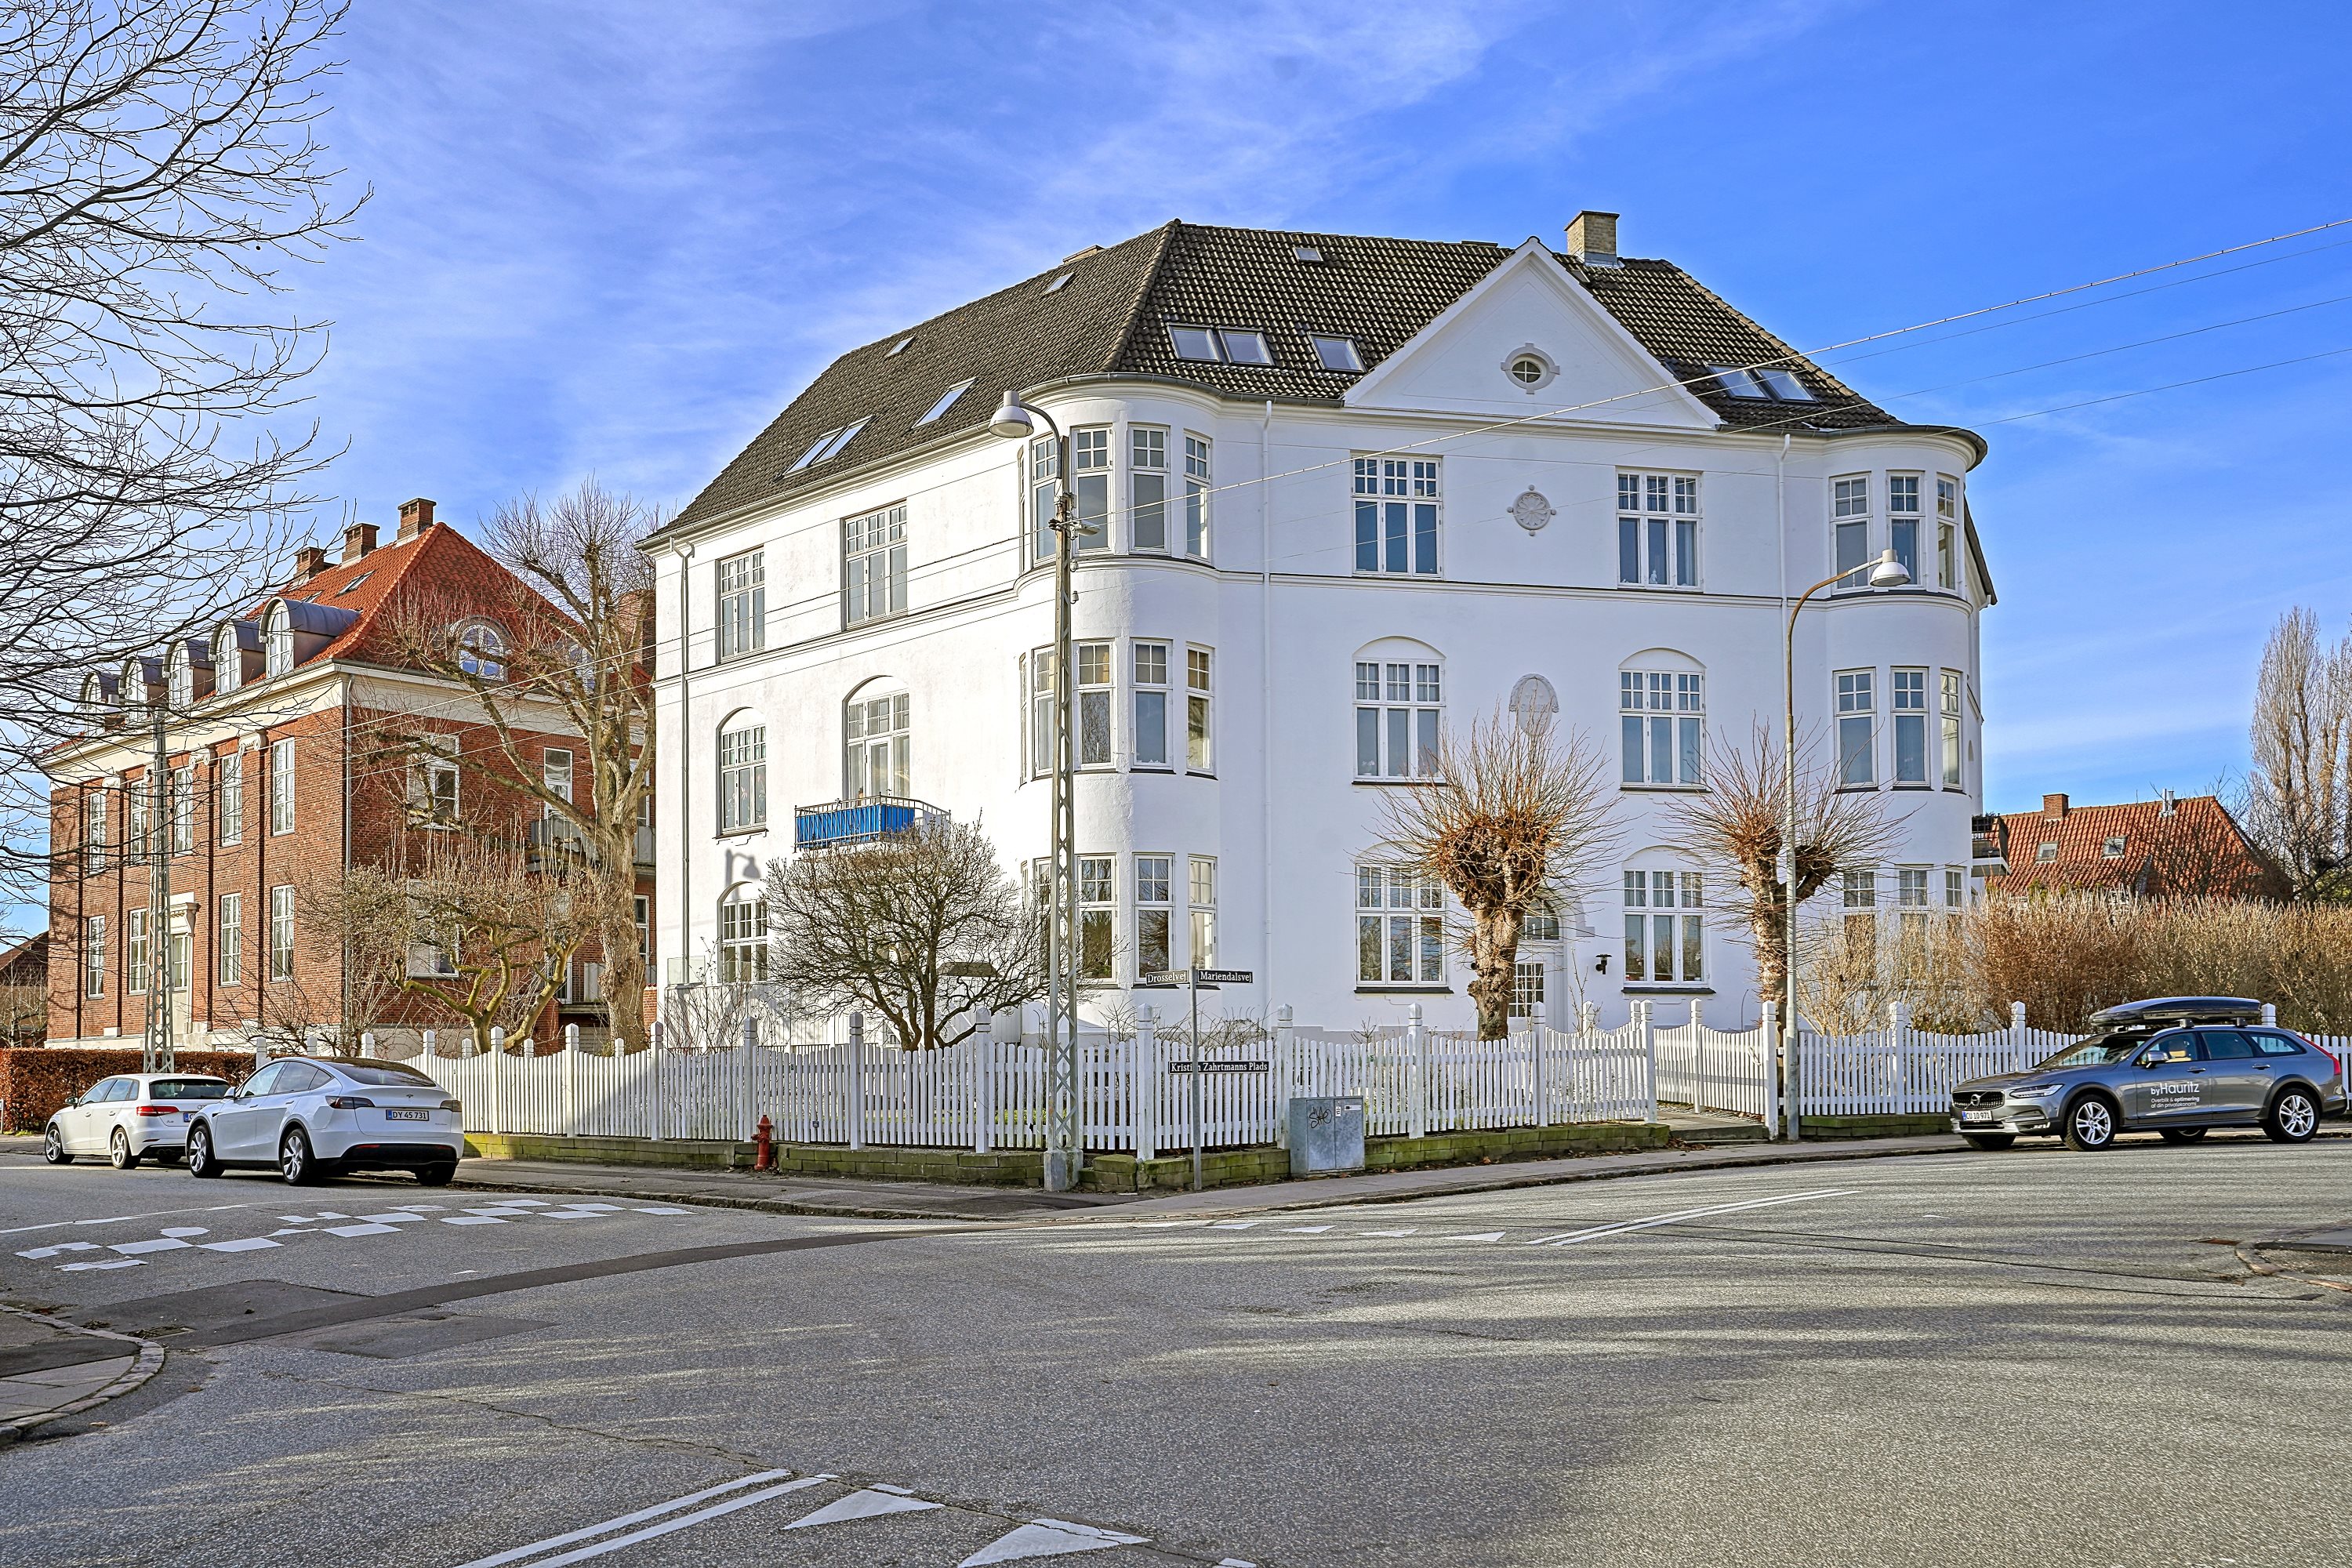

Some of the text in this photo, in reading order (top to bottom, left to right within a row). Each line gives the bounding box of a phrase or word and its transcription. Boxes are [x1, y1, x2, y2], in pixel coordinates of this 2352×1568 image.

[1147, 971, 1186, 983] Drosselvej
[1200, 971, 1251, 983] Mariendalsvej
[1171, 1062, 1268, 1072] Kristin Zahrtmanns Plads
